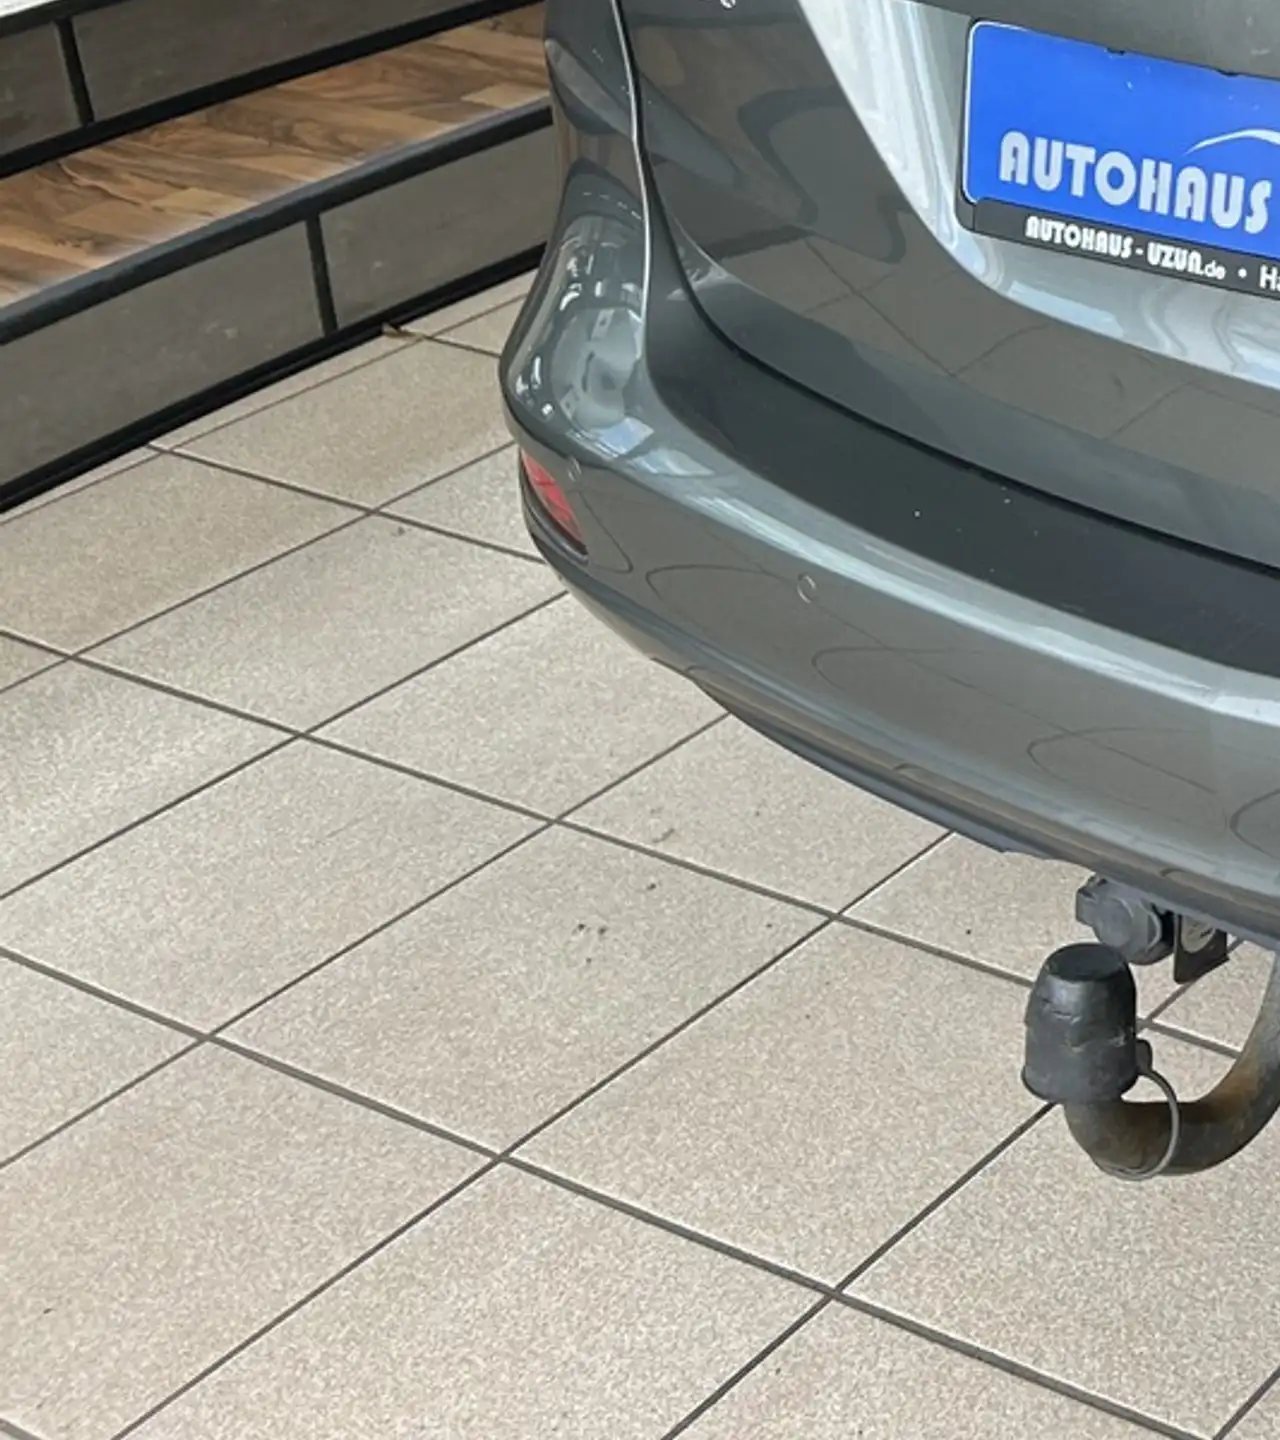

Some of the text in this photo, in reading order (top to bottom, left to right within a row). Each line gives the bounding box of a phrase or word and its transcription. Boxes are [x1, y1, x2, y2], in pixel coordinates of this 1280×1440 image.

[999, 130, 1273, 235] AUTOHAUS
[1025, 215, 1134, 259] AUTOHAUS
[1147, 241, 1227, 280] UZUN.de
